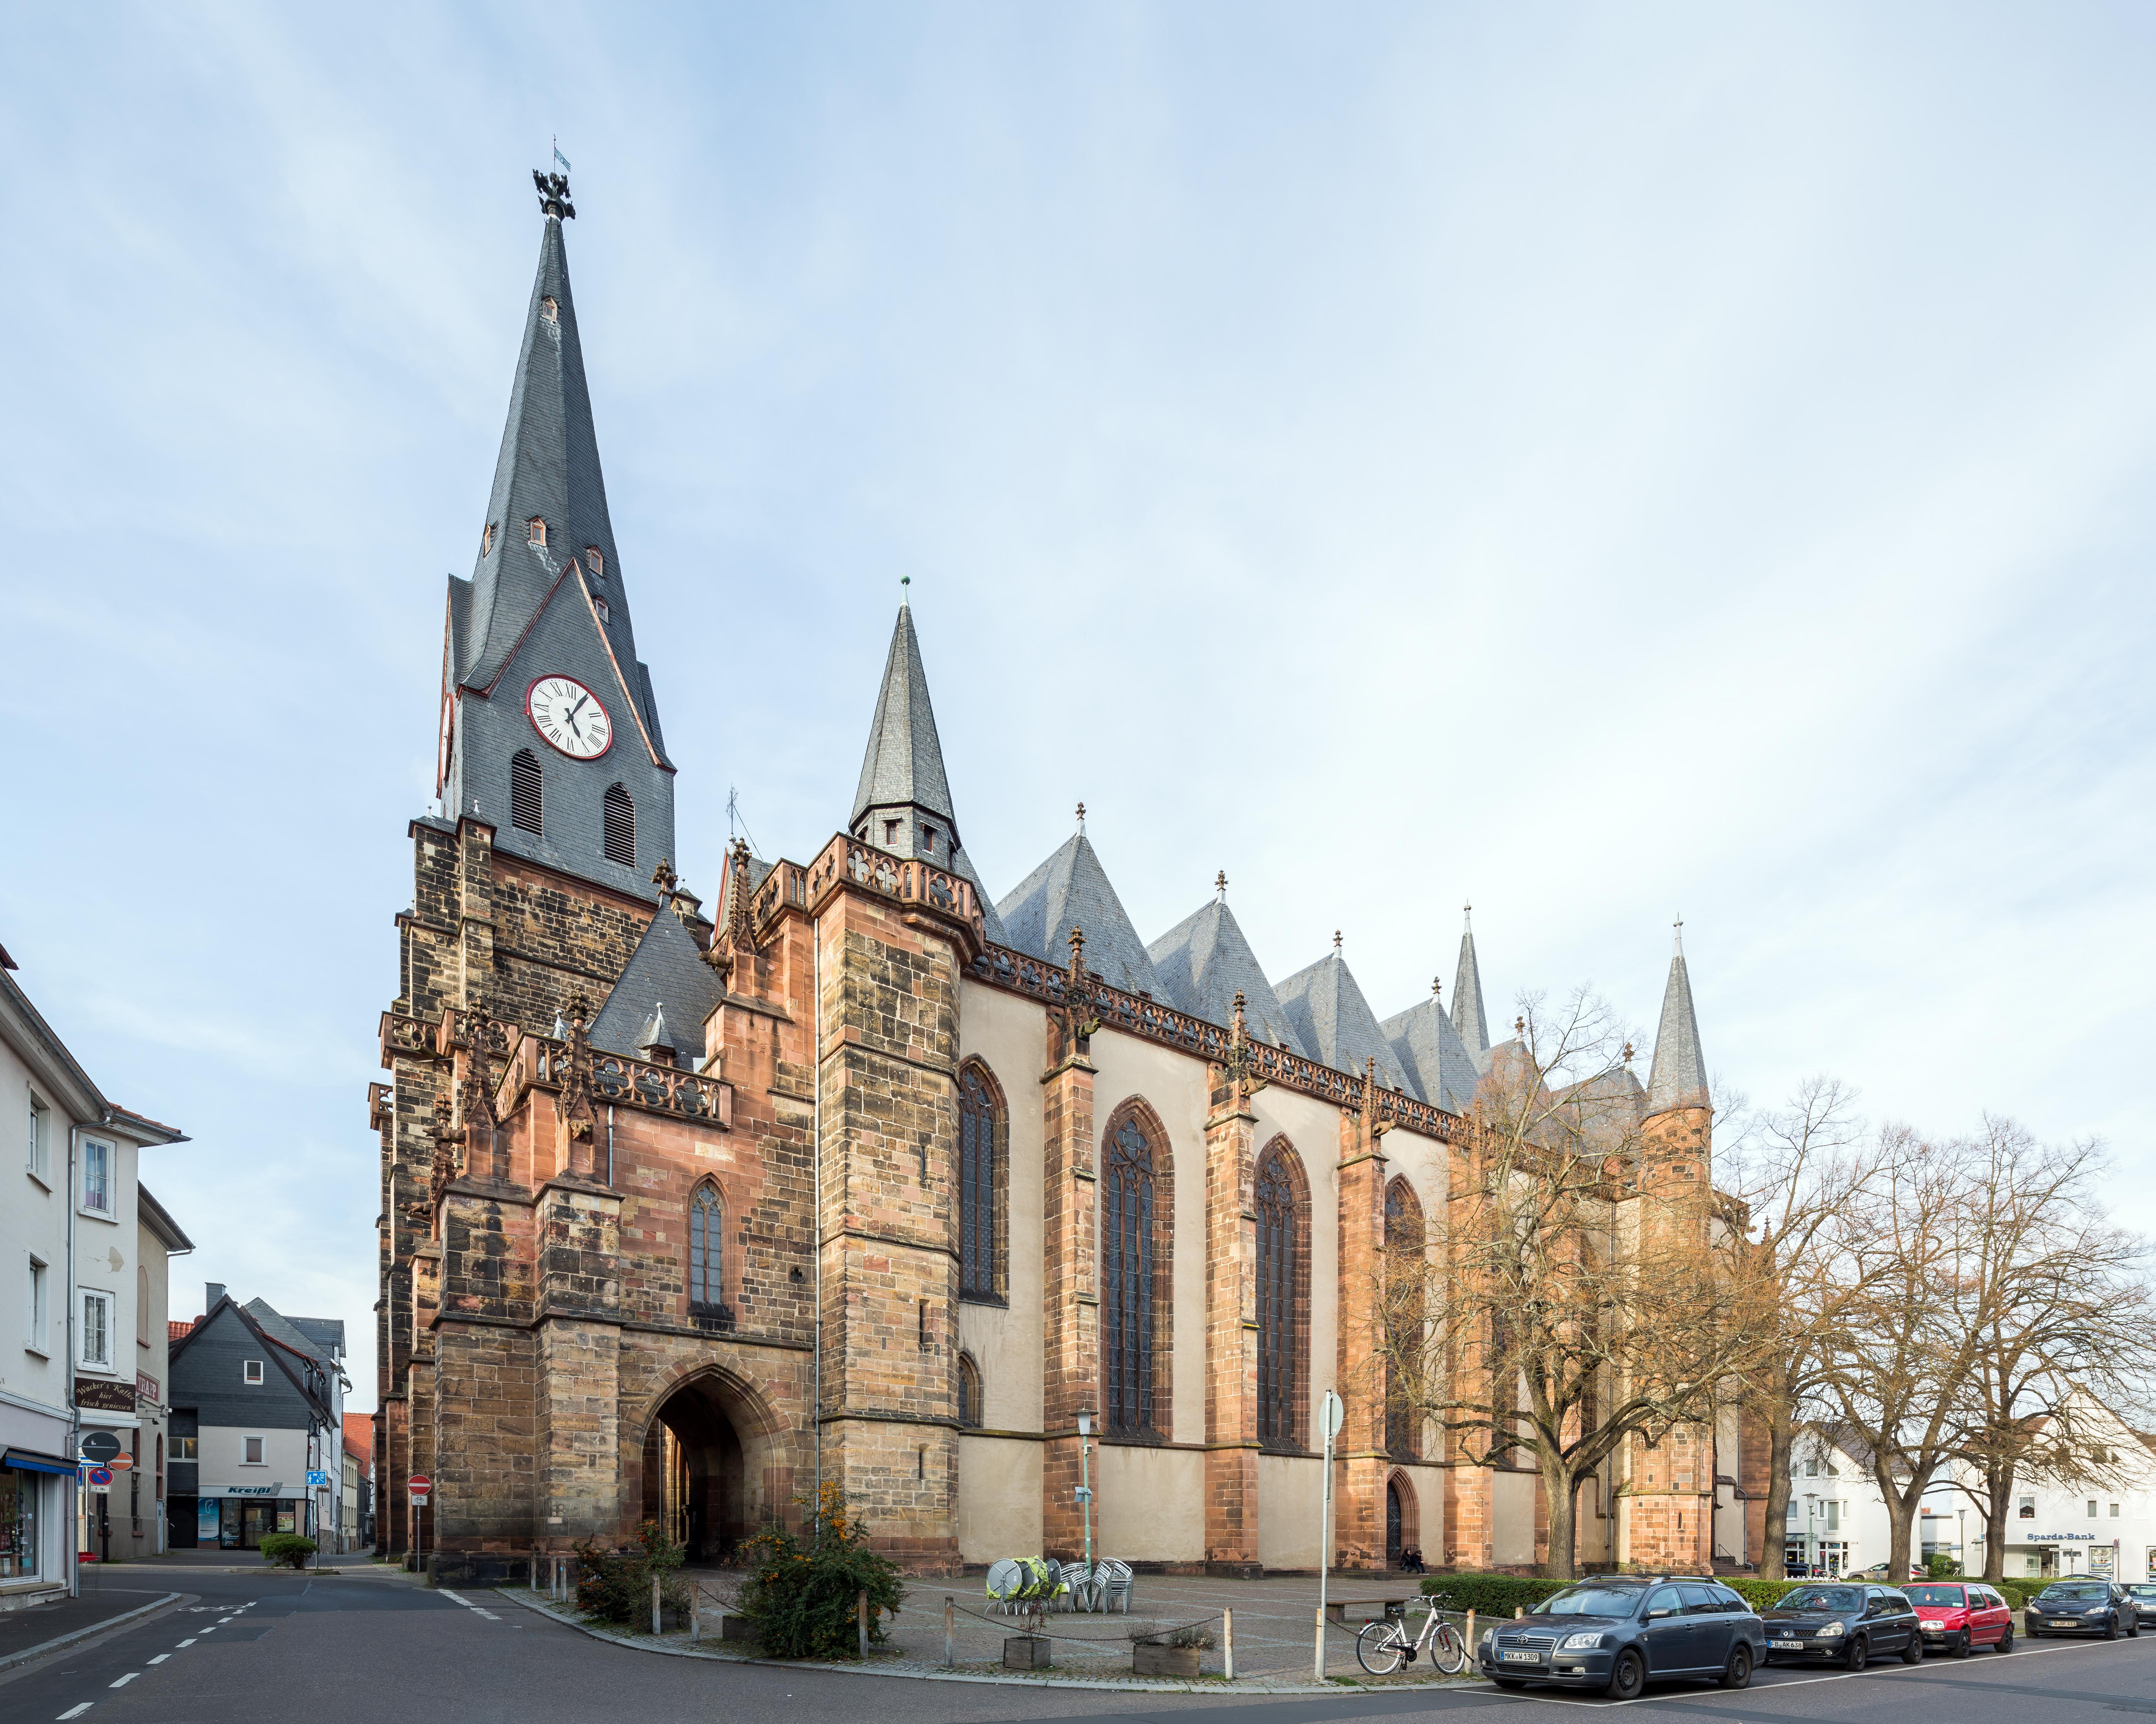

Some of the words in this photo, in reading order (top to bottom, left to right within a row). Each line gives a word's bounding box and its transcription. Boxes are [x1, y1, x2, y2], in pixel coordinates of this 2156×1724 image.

[538, 688, 553, 702] X
[565, 683, 577, 701] XII
[592, 723, 606, 736] III
[581, 739, 591, 753] V
[76, 1382, 109, 1395] Wacker's
[113, 1384, 135, 1401] Kaffee
[138, 1377, 156, 1398] TRAPP
[80, 1399, 99, 1407] frisch
[102, 1402, 131, 1410] geniessen
